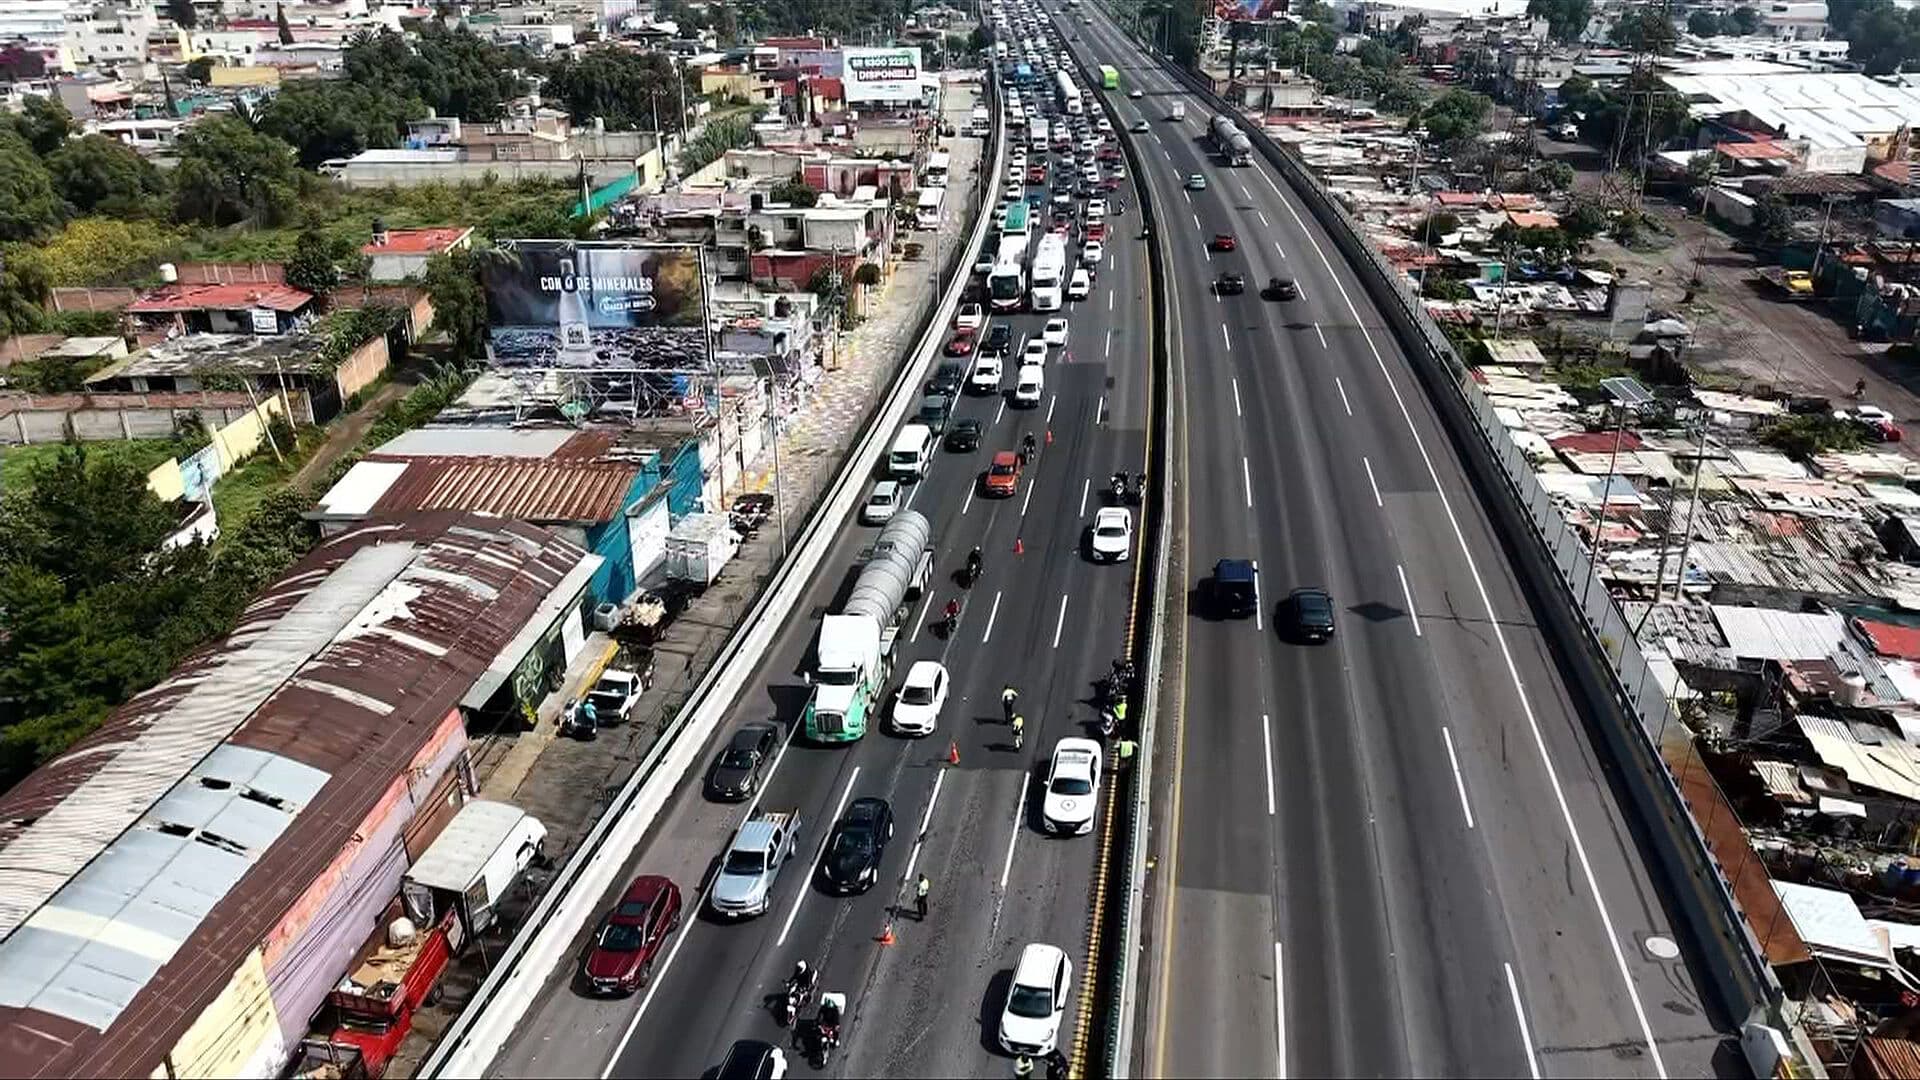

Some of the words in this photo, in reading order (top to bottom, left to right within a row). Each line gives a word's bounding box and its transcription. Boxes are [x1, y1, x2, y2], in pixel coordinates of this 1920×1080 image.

[859, 68, 916, 79] DISPONIBLE
[540, 276, 561, 291] CON
[575, 276, 590, 291] DE
[593, 276, 653, 292] MINERALES
